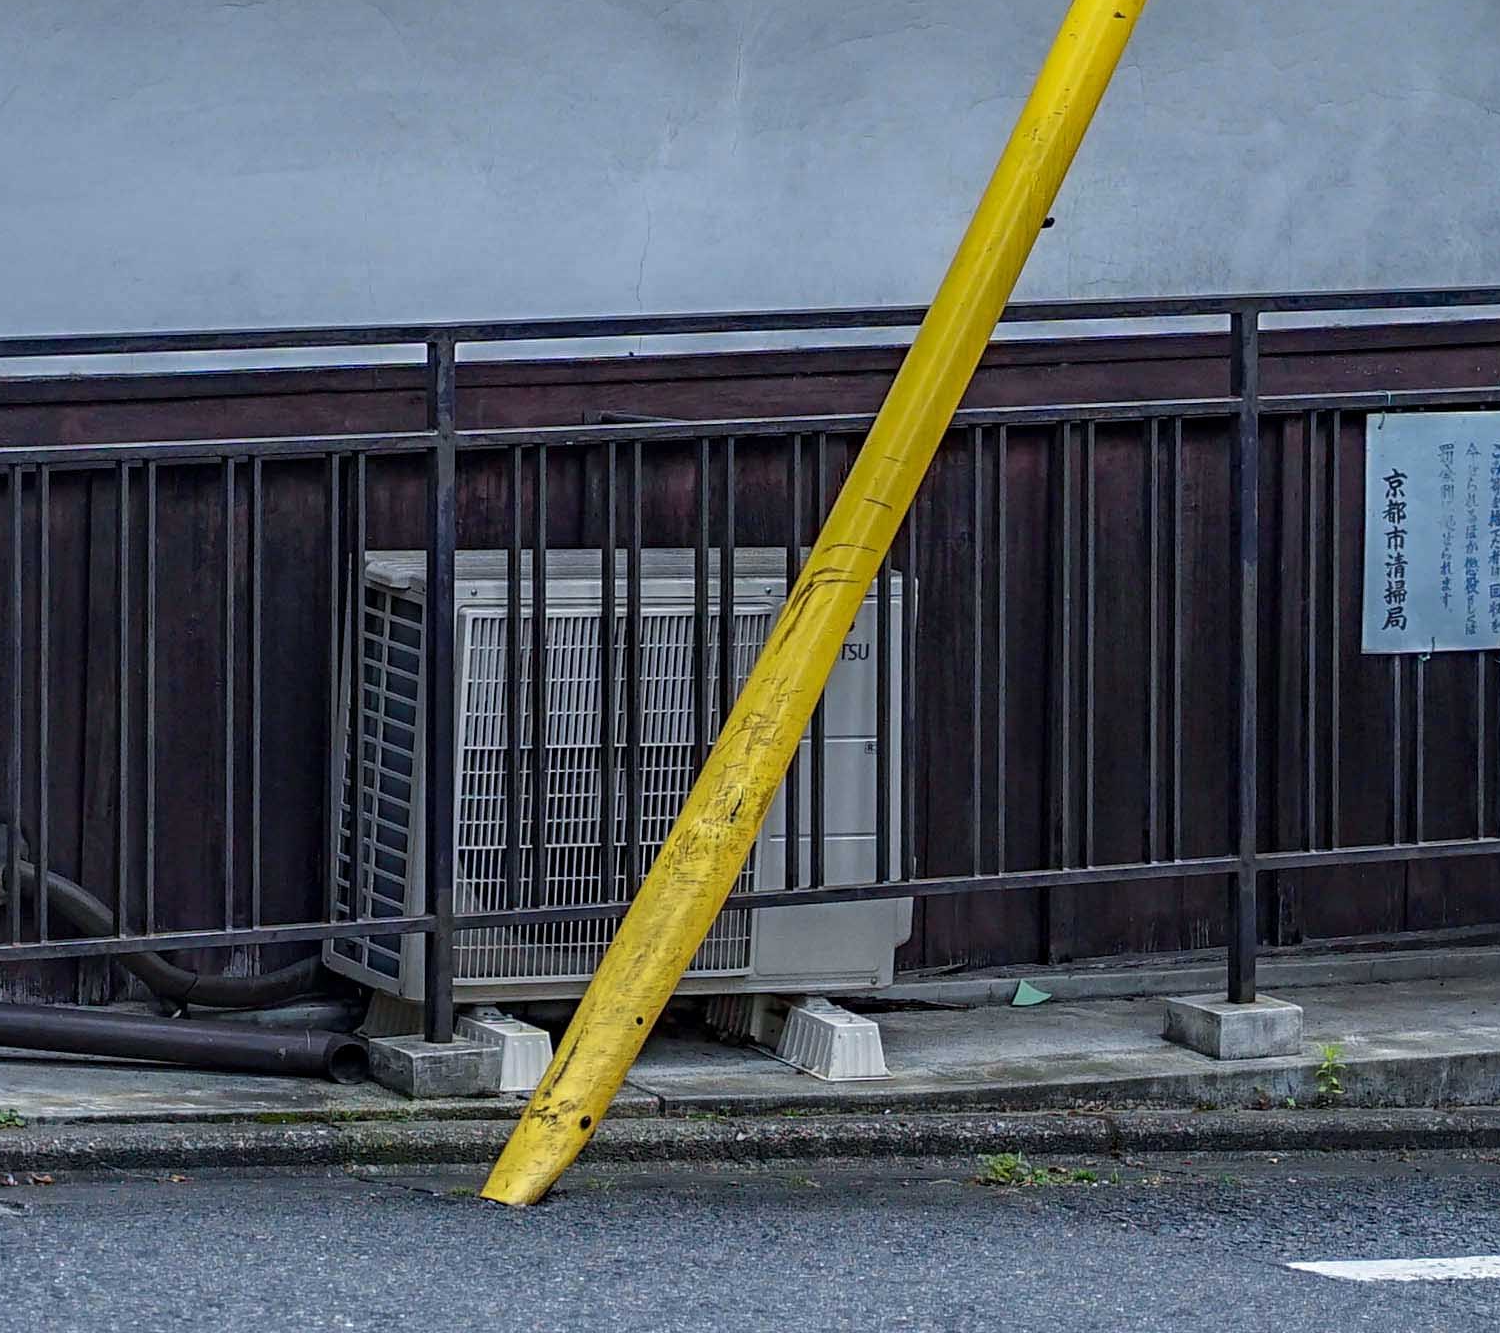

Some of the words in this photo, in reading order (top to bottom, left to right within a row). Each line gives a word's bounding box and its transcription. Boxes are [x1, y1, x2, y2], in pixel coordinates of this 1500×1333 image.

[1382, 468, 1408, 632] 京都市清掃局
